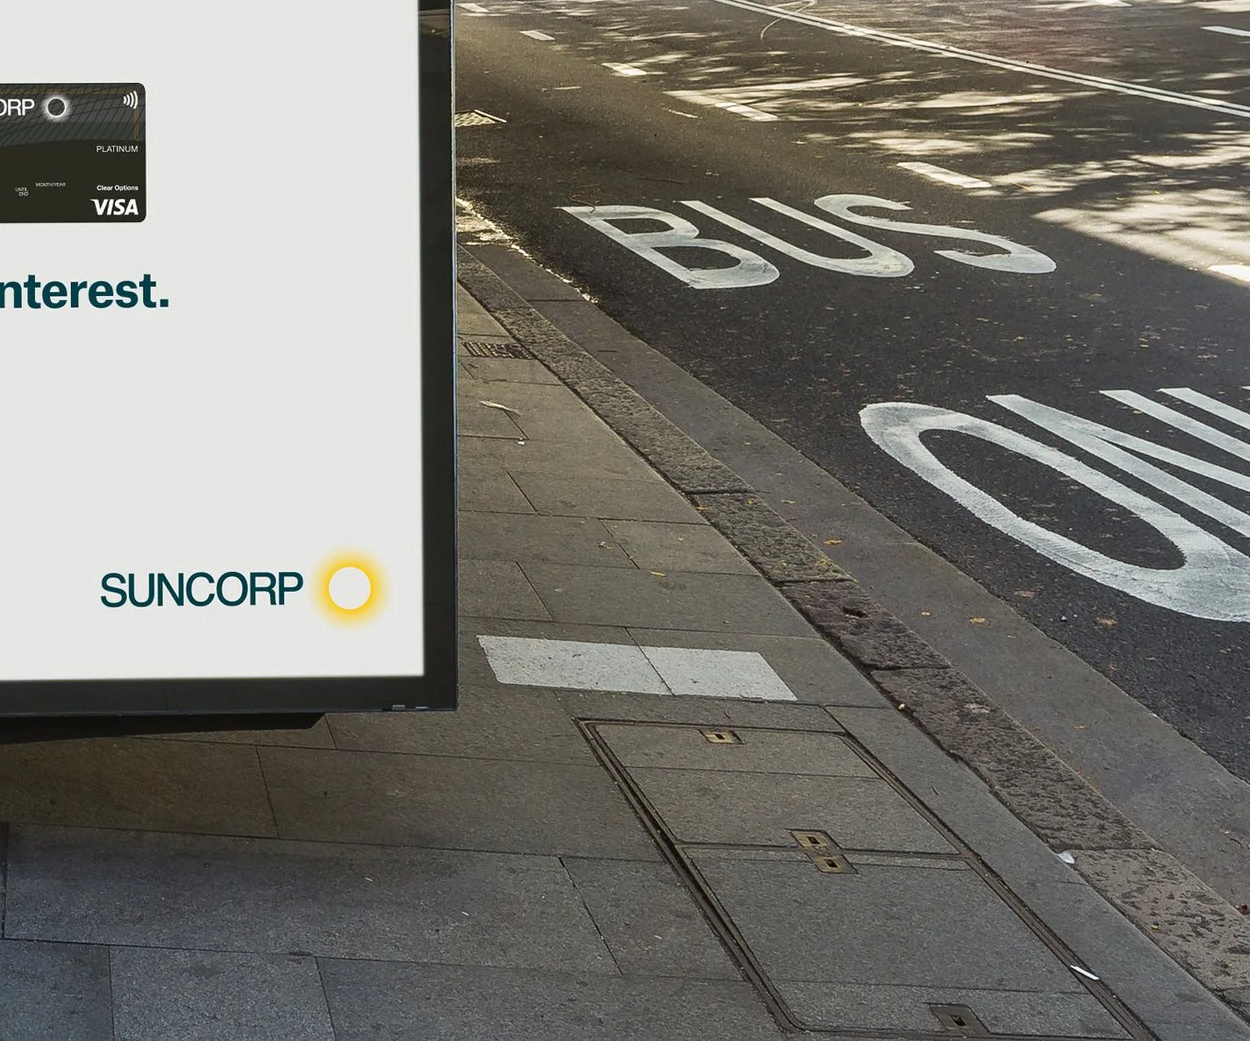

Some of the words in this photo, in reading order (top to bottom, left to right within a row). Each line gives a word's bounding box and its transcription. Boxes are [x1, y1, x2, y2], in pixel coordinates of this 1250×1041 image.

[96, 145, 139, 153] PLATINUM
[96, 184, 113, 192] Clear
[114, 184, 139, 192] Options
[90, 198, 139, 216] VISA
[555, 194, 1057, 289] BUS
[100, 571, 304, 609] SUNCORP
